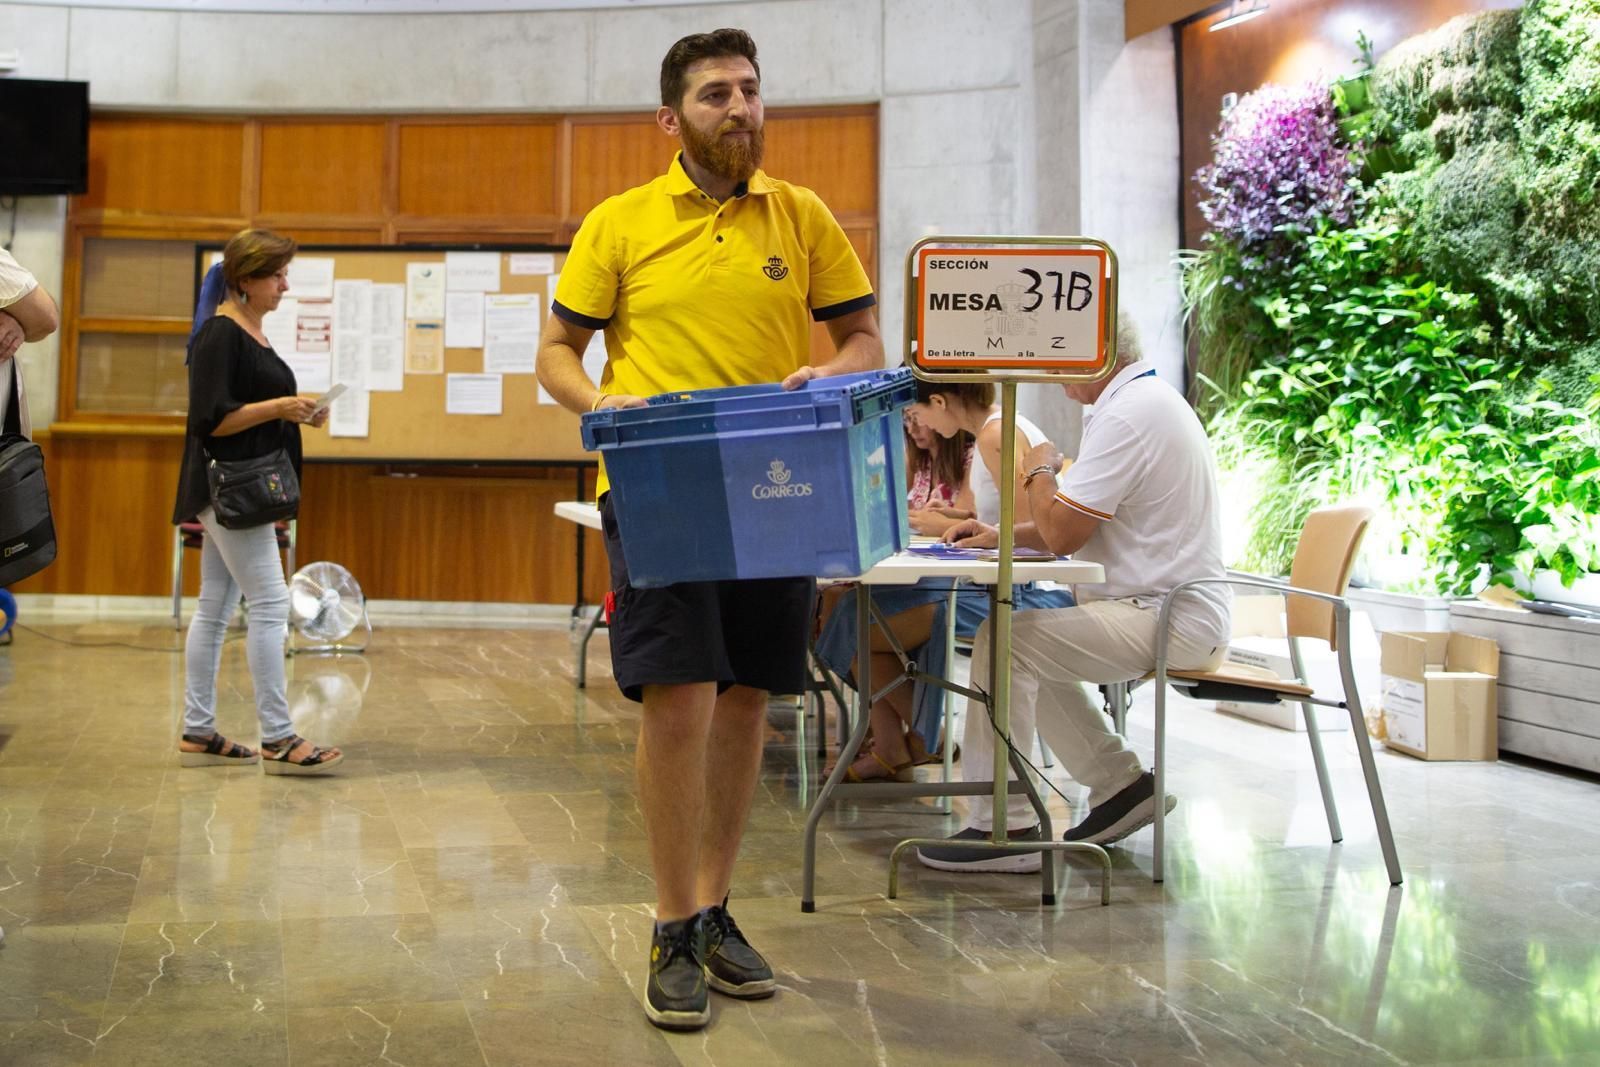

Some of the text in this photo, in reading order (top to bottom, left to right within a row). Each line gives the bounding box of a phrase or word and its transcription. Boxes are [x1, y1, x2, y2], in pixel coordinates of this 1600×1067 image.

[929, 258, 989, 270] SECCIÓN
[1018, 267, 1093, 313] 37B
[929, 293, 1003, 311] MESA
[986, 336, 1005, 350] M
[751, 483, 813, 500] CORREOS
